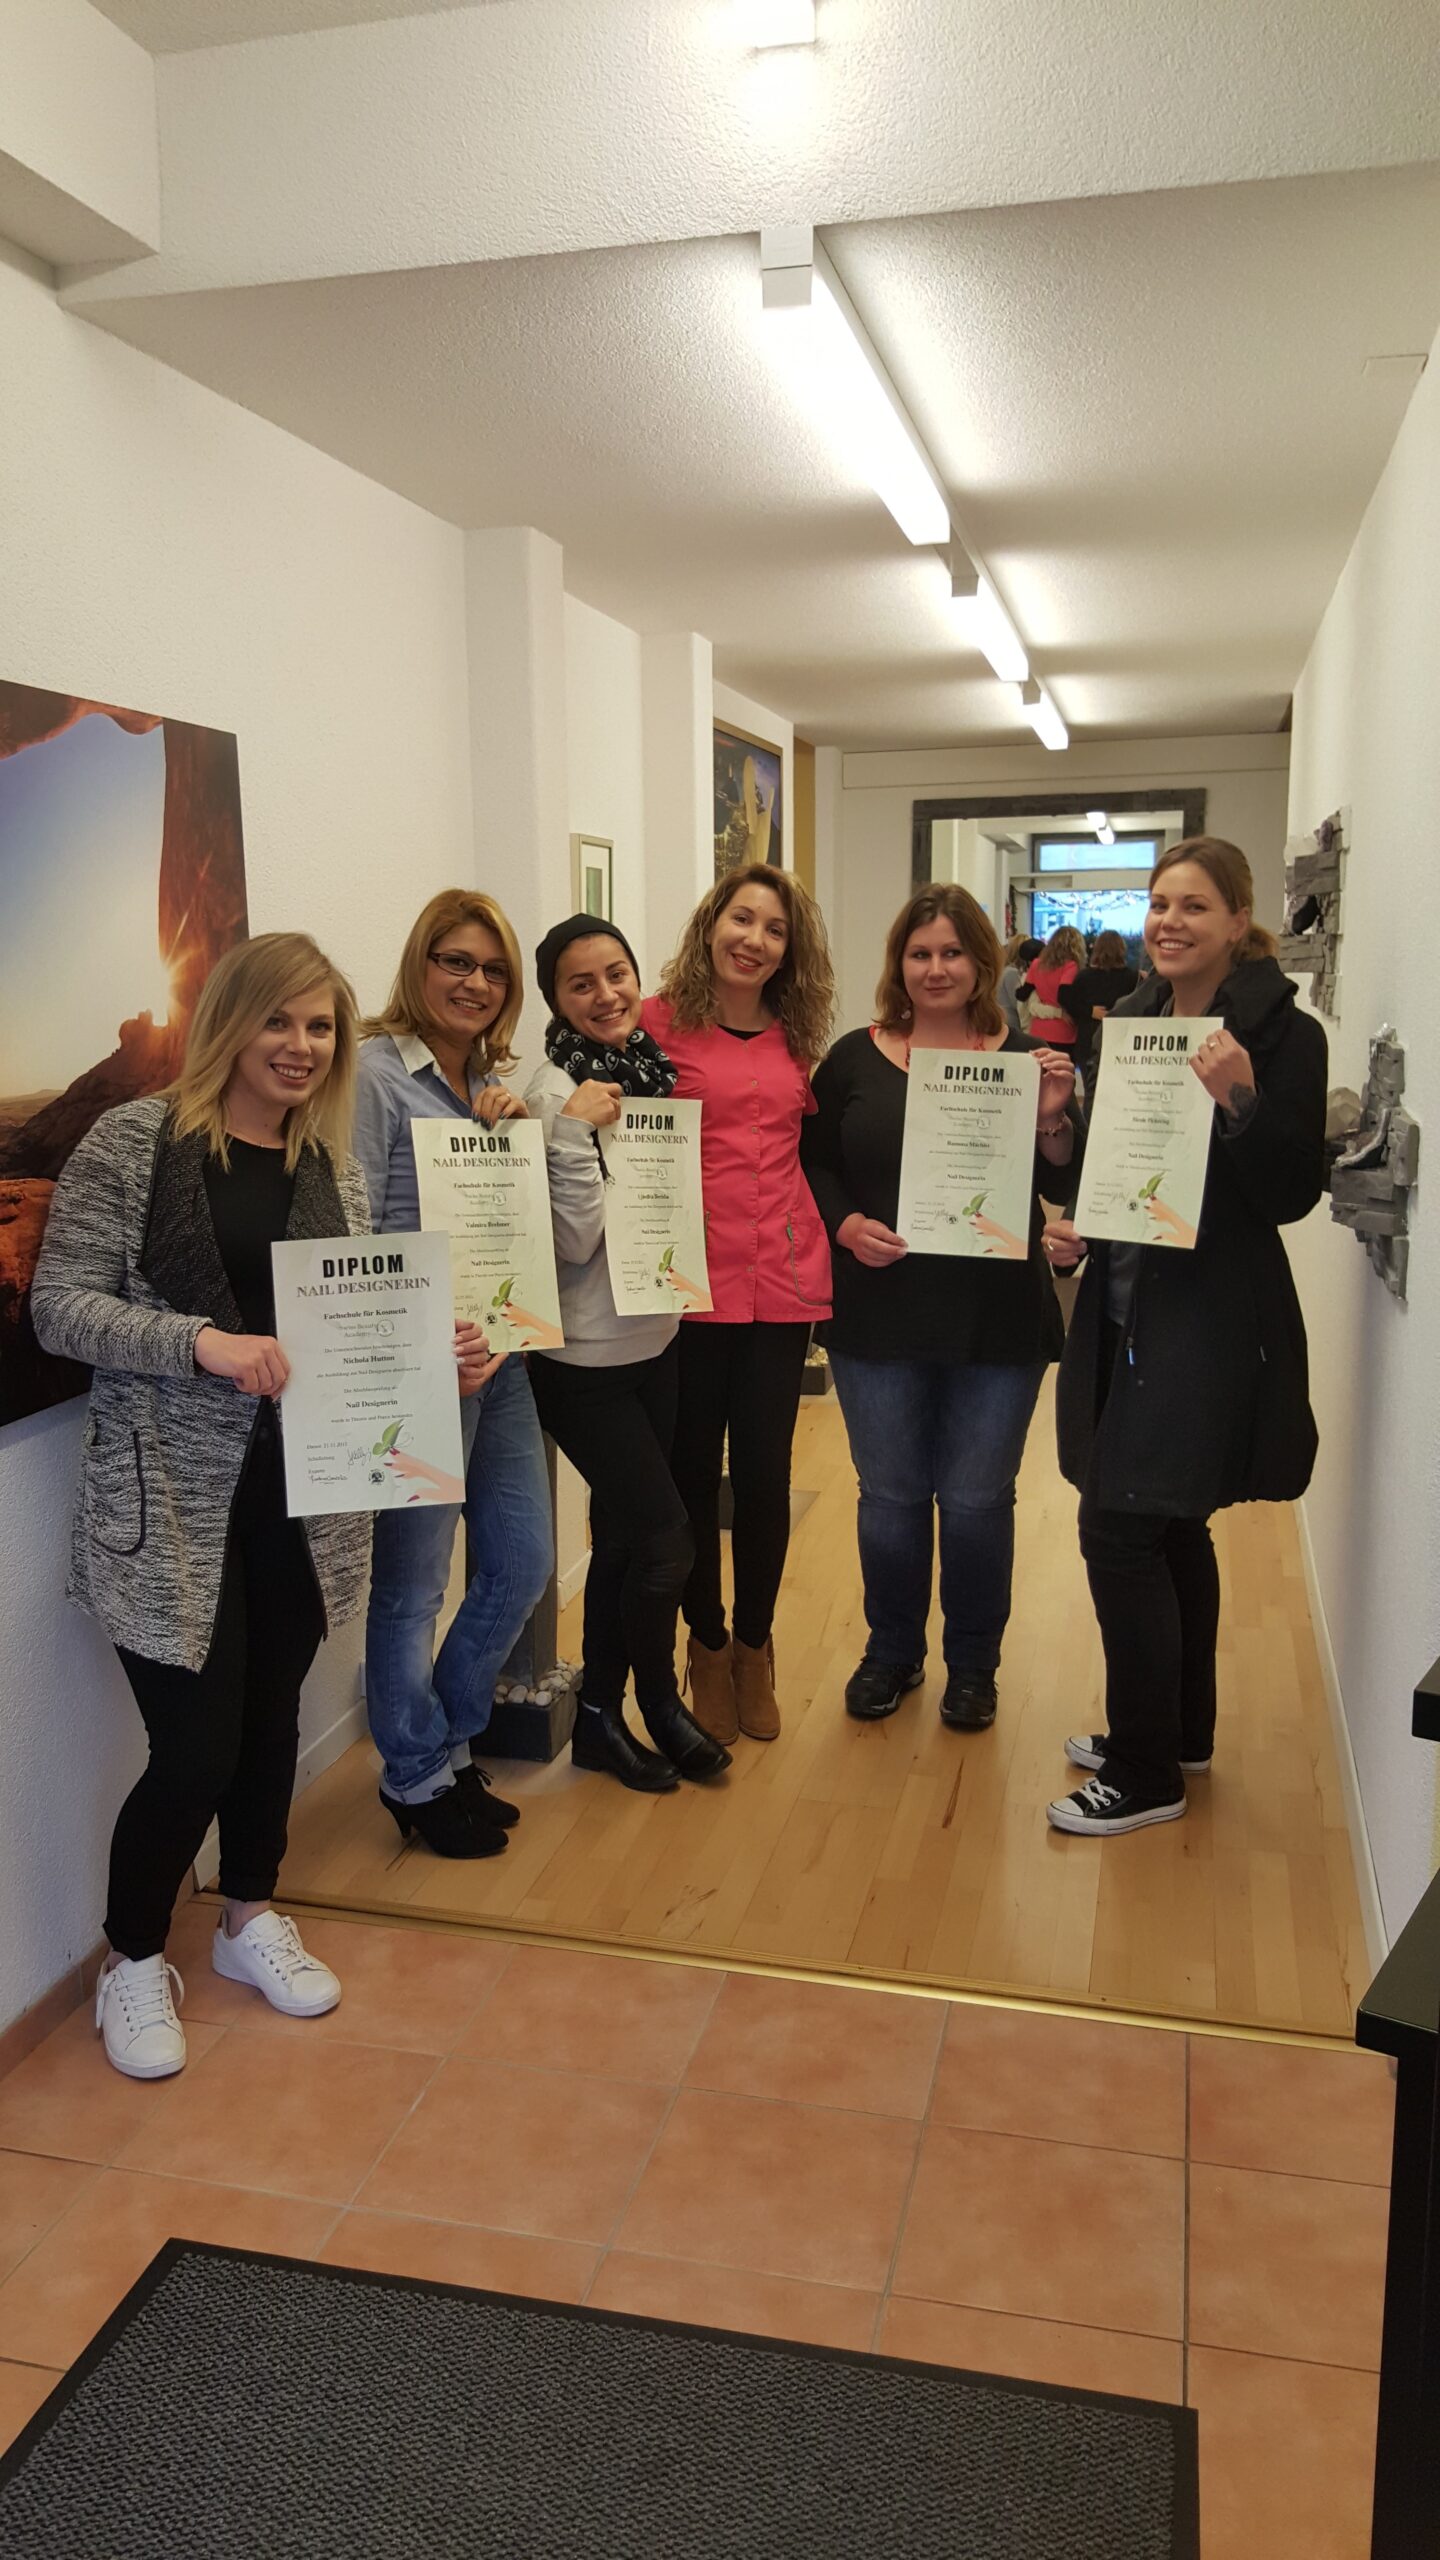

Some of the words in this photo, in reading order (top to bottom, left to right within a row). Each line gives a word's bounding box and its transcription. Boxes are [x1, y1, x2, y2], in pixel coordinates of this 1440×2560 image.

[1134, 1036, 1188, 1051] DIPLOM
[1114, 1056, 1139, 1065] NAIL
[944, 1066, 1004, 1082] DIPLOM
[923, 1083, 951, 1093] NAIL
[953, 1085, 1022, 1096] DESIGNERIN
[626, 1114, 674, 1130] DIPLOM
[450, 1137, 511, 1152] DIPLOM
[611, 1133, 634, 1143] NAIL
[635, 1134, 688, 1144] DESIGNERIN
[433, 1158, 461, 1168] NAIL
[464, 1158, 531, 1168] DESIGNERIN
[322, 1254, 404, 1278] DIPLOM
[296, 1284, 335, 1298] NAIL
[338, 1277, 430, 1295] DESIGNERIN
[324, 1311, 361, 1320] Fachschule
[376, 1307, 408, 1316] Kosmetik
[361, 1399, 398, 1408] Designerin
